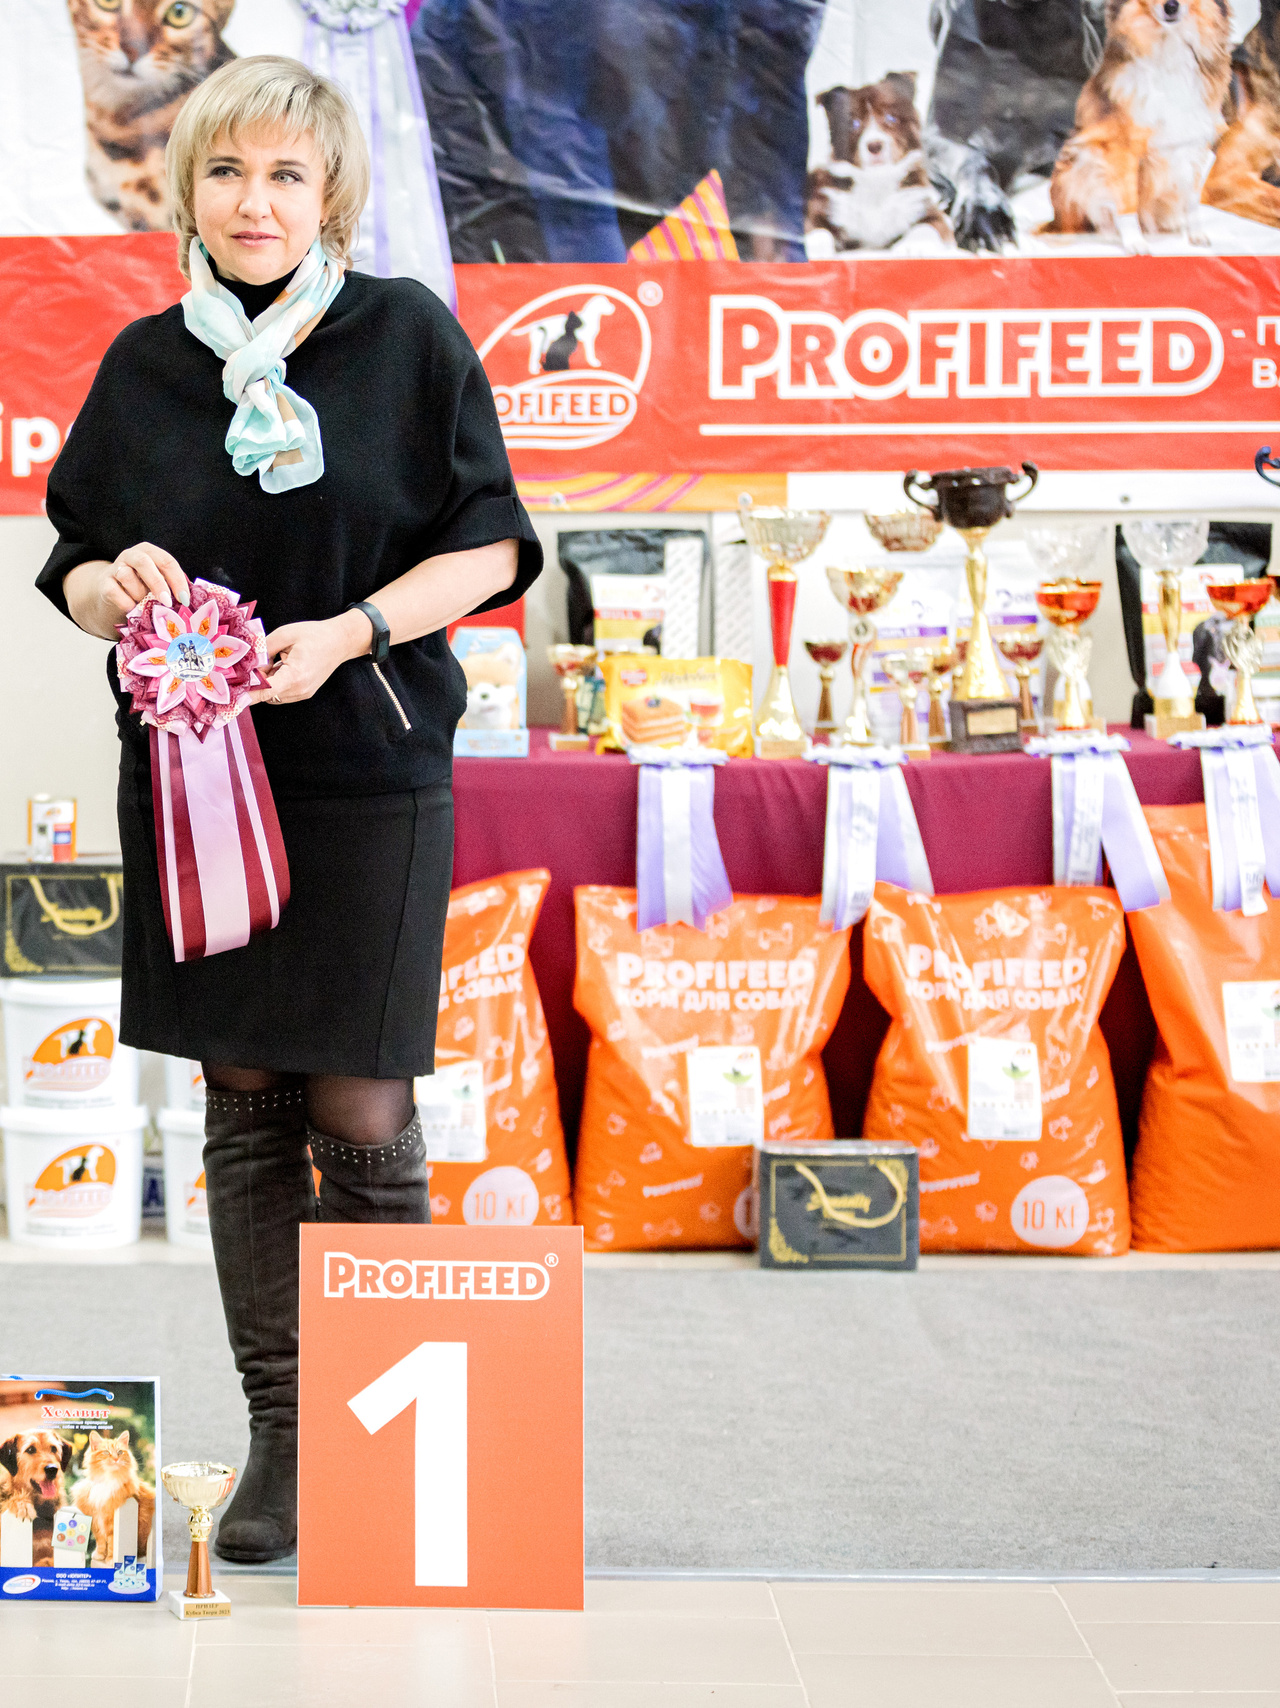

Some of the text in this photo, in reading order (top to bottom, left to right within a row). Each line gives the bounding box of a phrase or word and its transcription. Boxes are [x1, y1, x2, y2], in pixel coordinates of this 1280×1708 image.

[708, 294, 1225, 400] PROFIFEED
[492, 389, 634, 420] OFIFEED
[616, 951, 815, 990] PROFIFEED
[475, 1190, 497, 1221] 10
[1022, 1199, 1045, 1230] 10
[324, 1252, 551, 1300] PROFIFEED
[41, 1405, 111, 1419] Хелавит
[347, 1341, 468, 1588] 1
